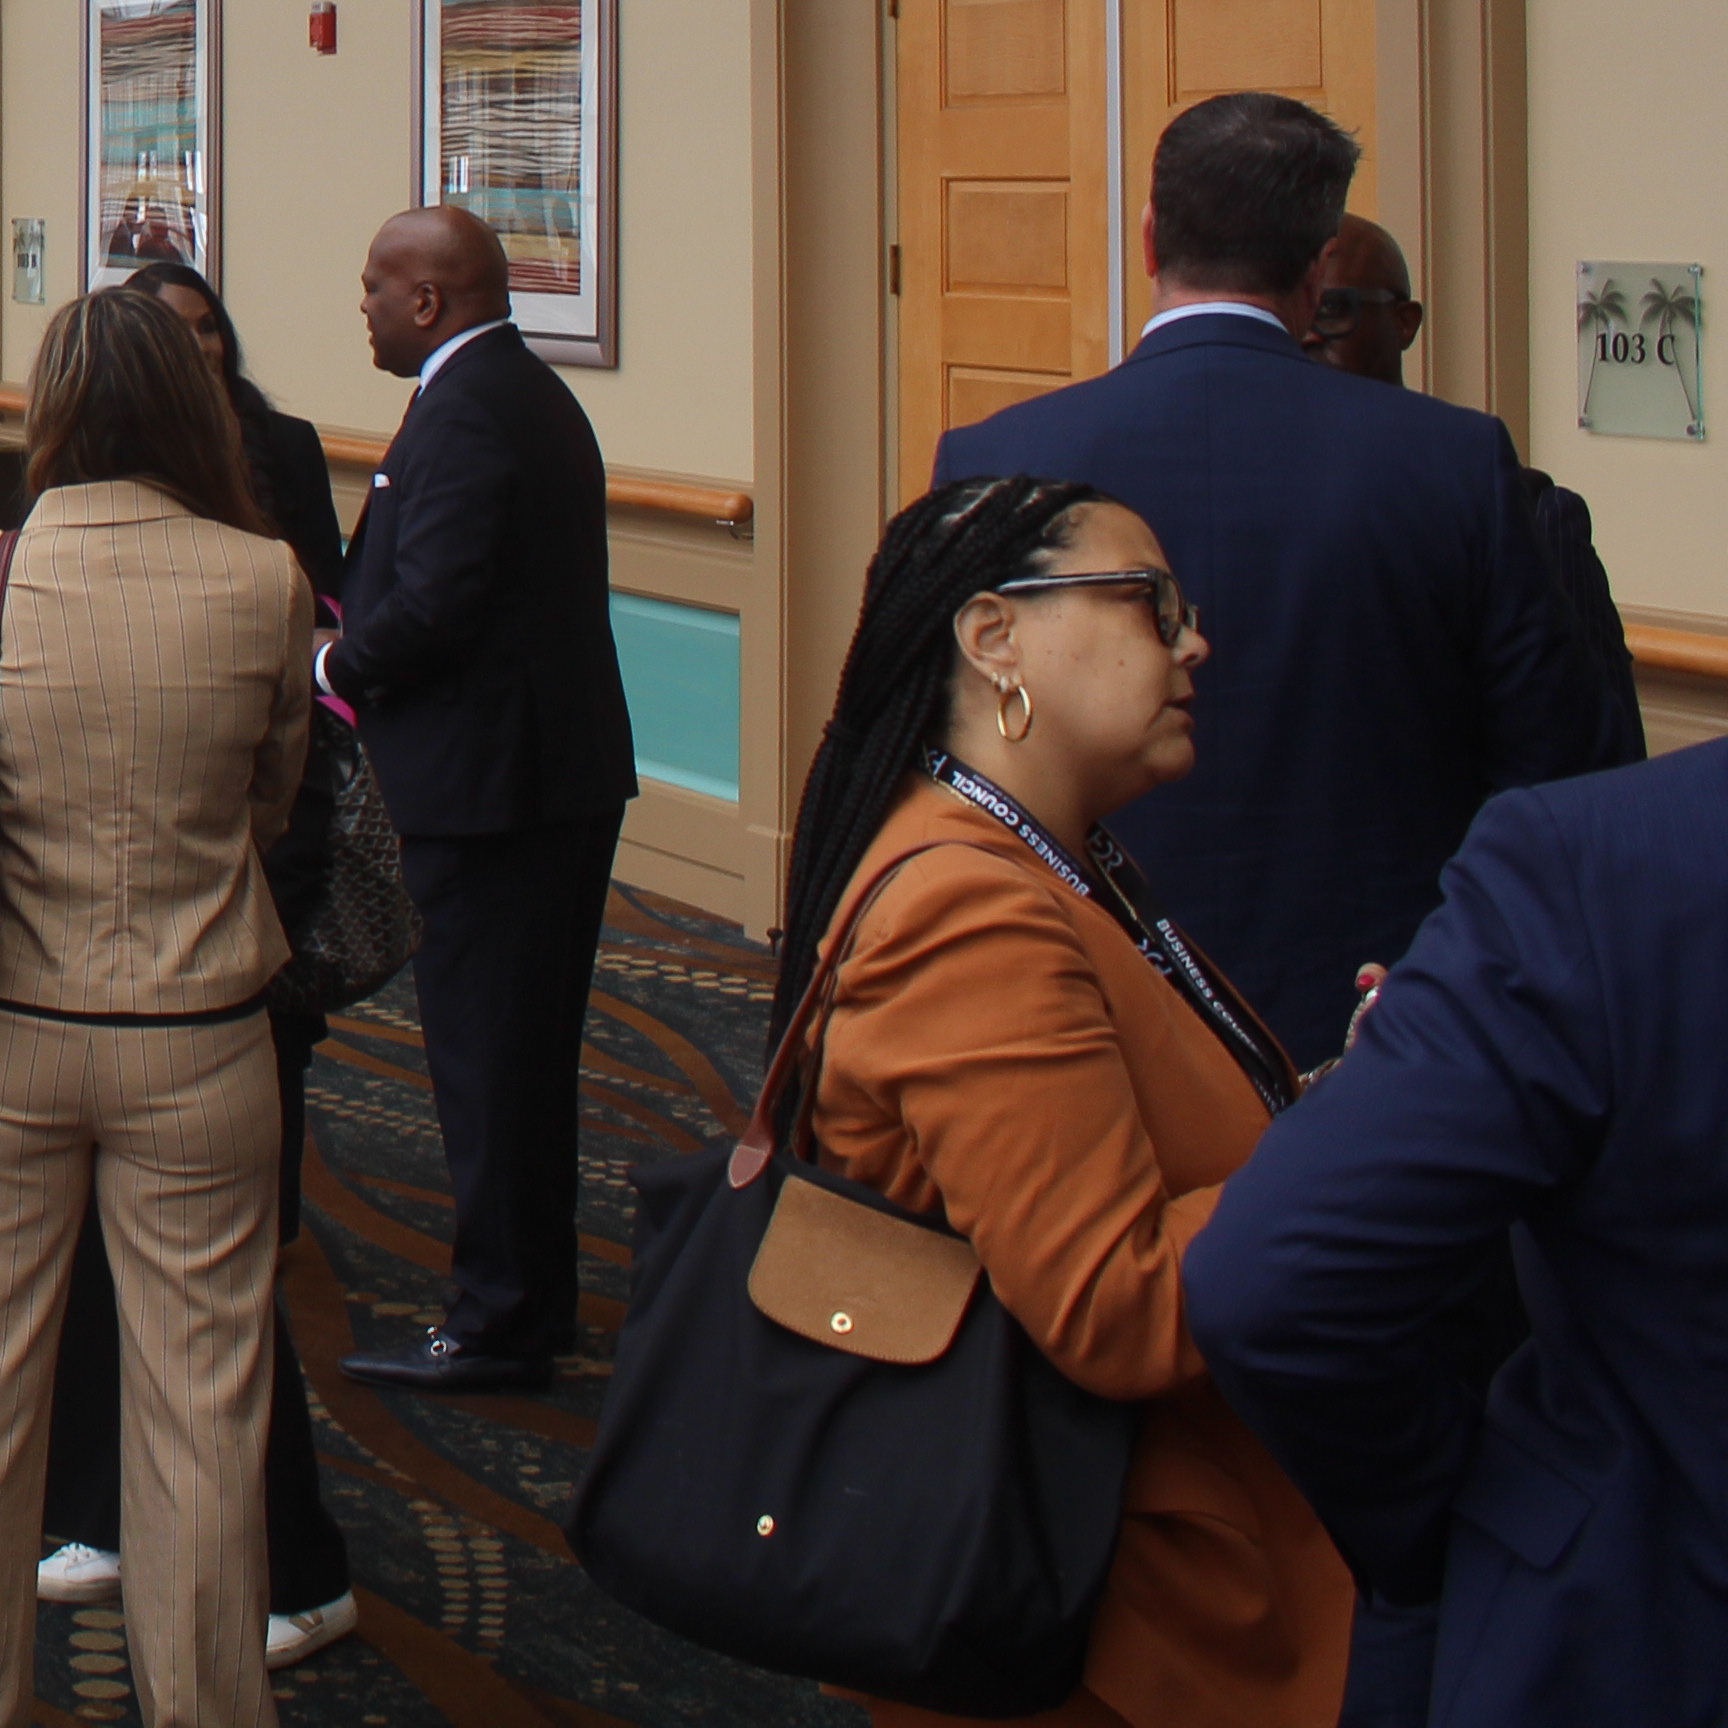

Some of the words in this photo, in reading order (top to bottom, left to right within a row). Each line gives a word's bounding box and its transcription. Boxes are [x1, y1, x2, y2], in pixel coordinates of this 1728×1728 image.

[1596, 332, 1646, 364] 103
[1657, 333, 1675, 365] C
[951, 770, 1020, 827] COUNCIL
[1017, 823, 1091, 898] BUSINESS
[1155, 918, 1215, 999] BUSINESS
